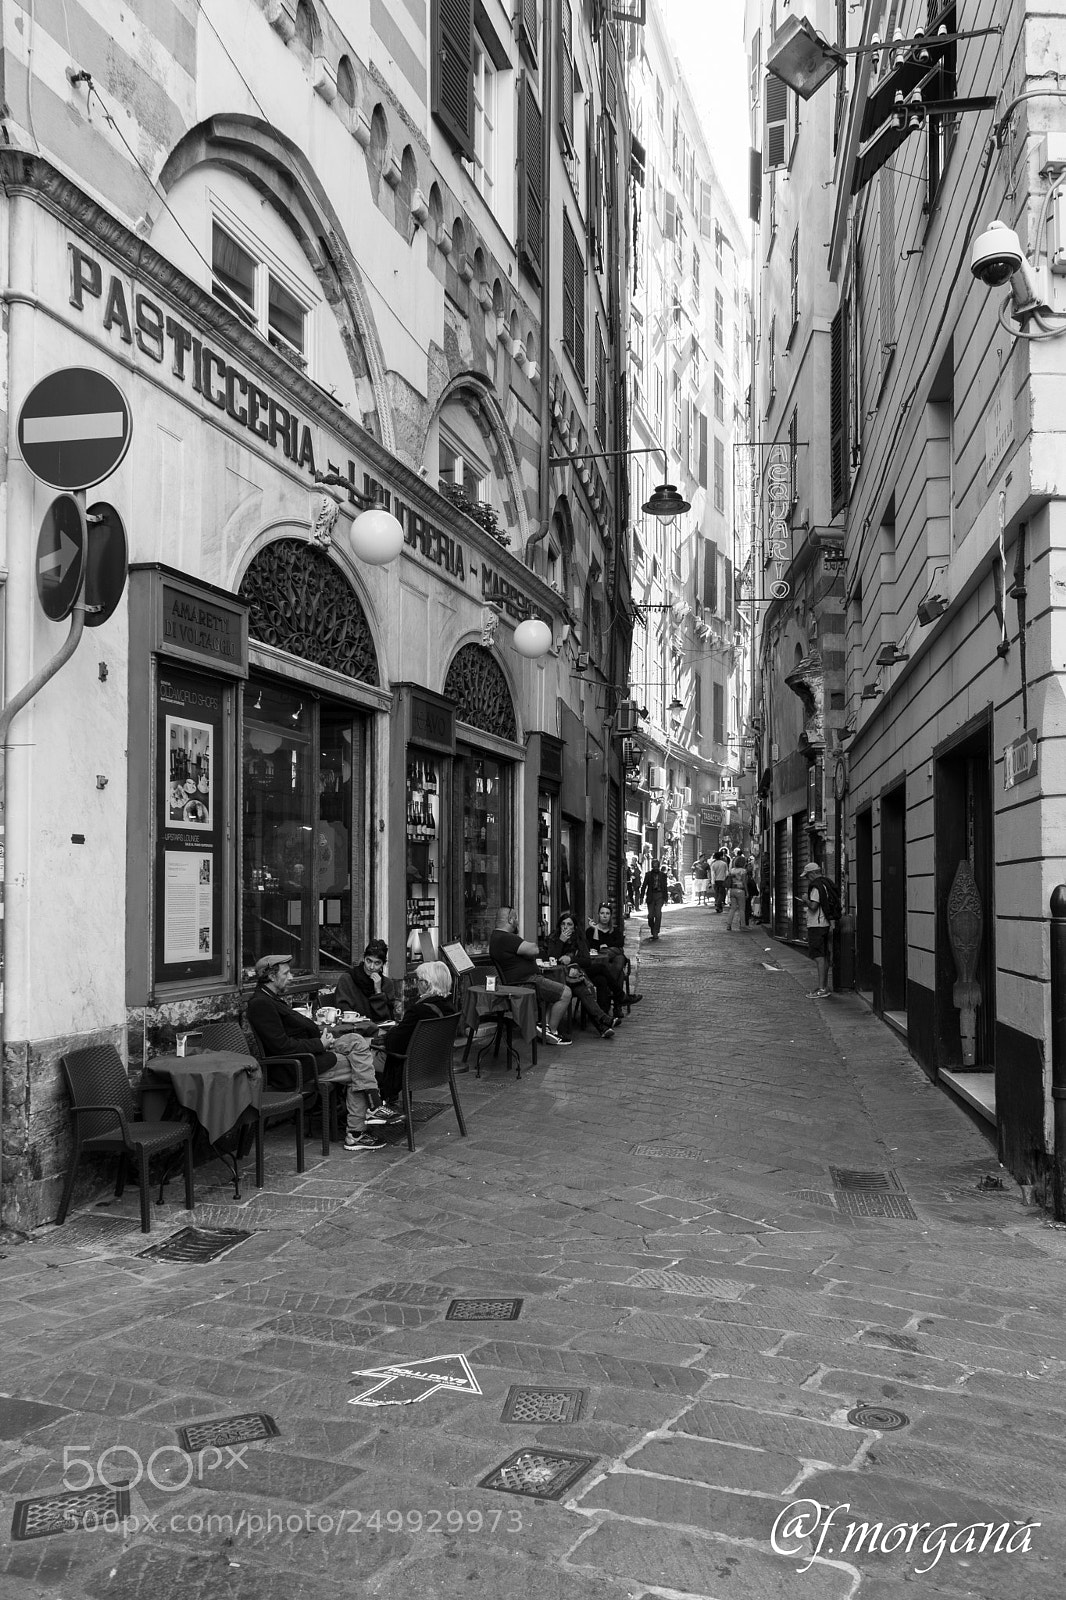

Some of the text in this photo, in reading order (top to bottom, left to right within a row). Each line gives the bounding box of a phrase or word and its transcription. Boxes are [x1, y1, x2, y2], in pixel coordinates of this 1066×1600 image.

[67, 242, 316, 475] PASTICCERIA
[767, 444, 790, 599] ACQUARIO
[165, 619, 235, 657] DI VOLTAGGIO
[171, 599, 230, 635] AMARETTI
